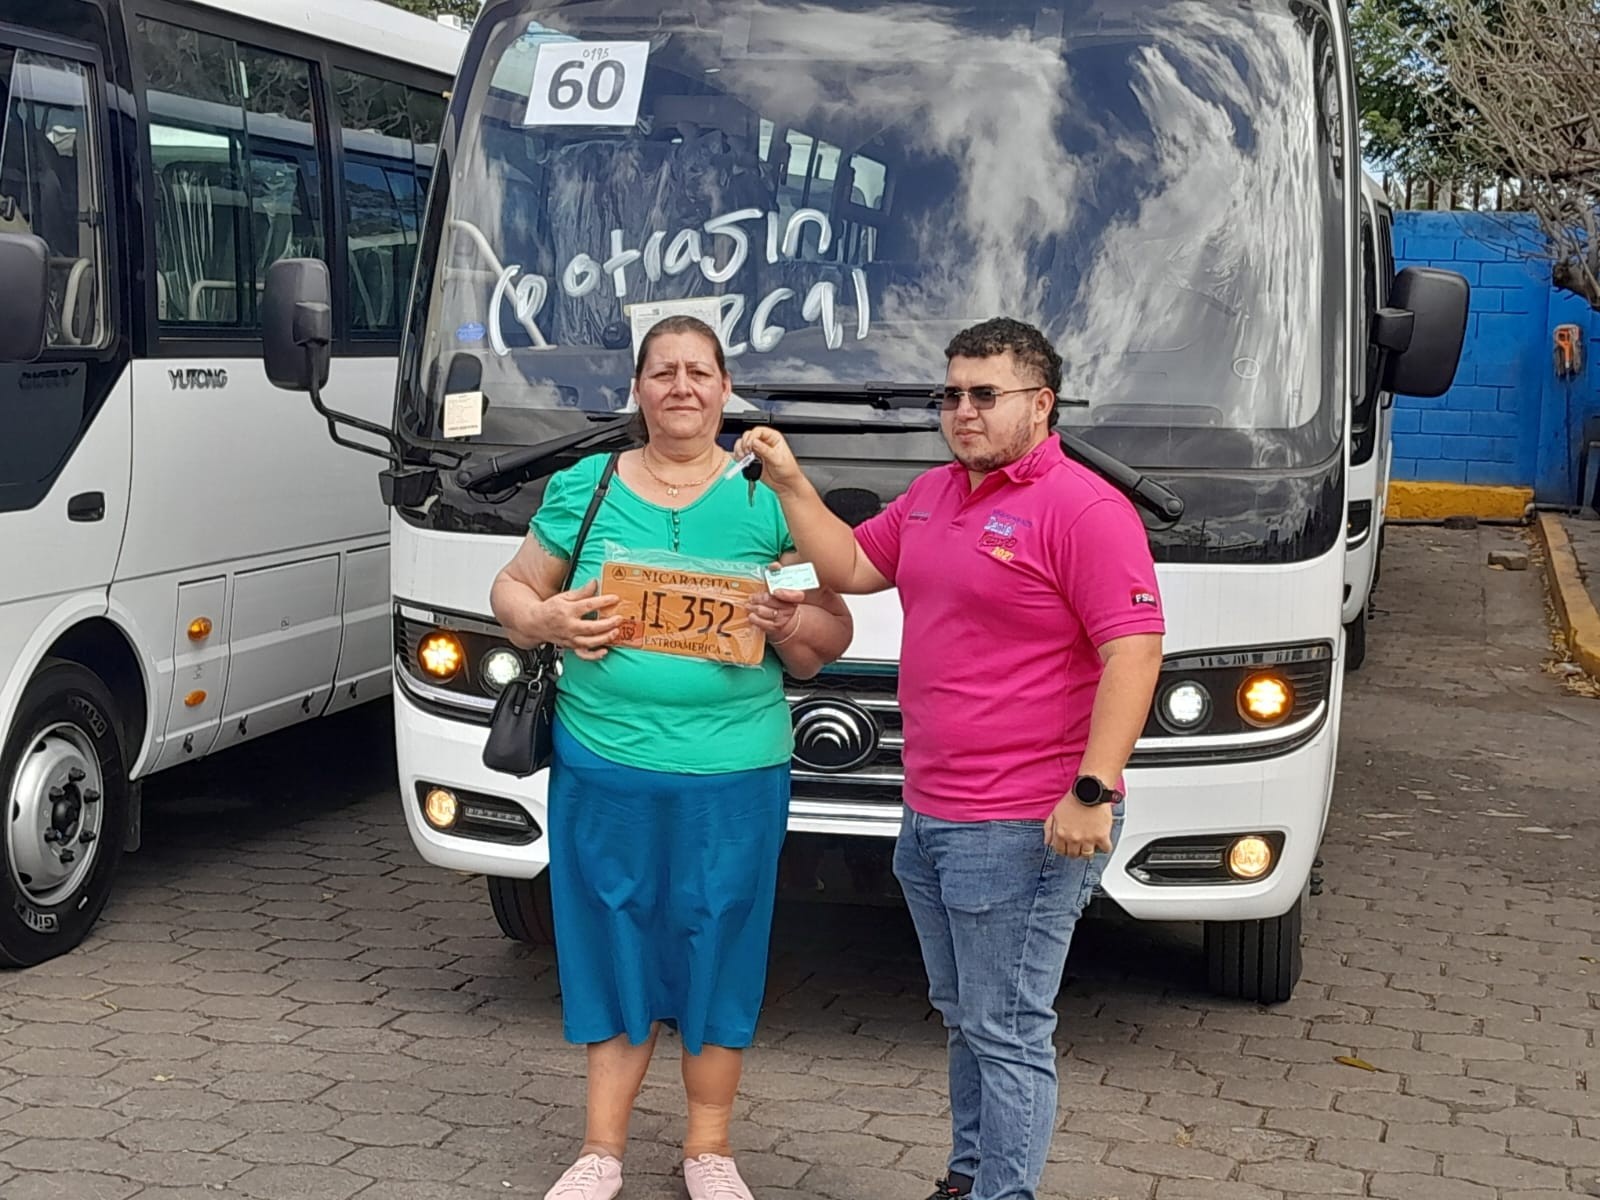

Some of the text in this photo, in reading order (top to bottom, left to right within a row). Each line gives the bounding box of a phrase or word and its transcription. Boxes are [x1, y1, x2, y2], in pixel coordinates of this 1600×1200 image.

[548, 60, 625, 110] 60
[168, 368, 228, 390] YUTONG
[641, 570, 731, 590] NICARAGUA
[679, 595, 735, 637] 352
[642, 635, 721, 655] ENTROAMERICA
